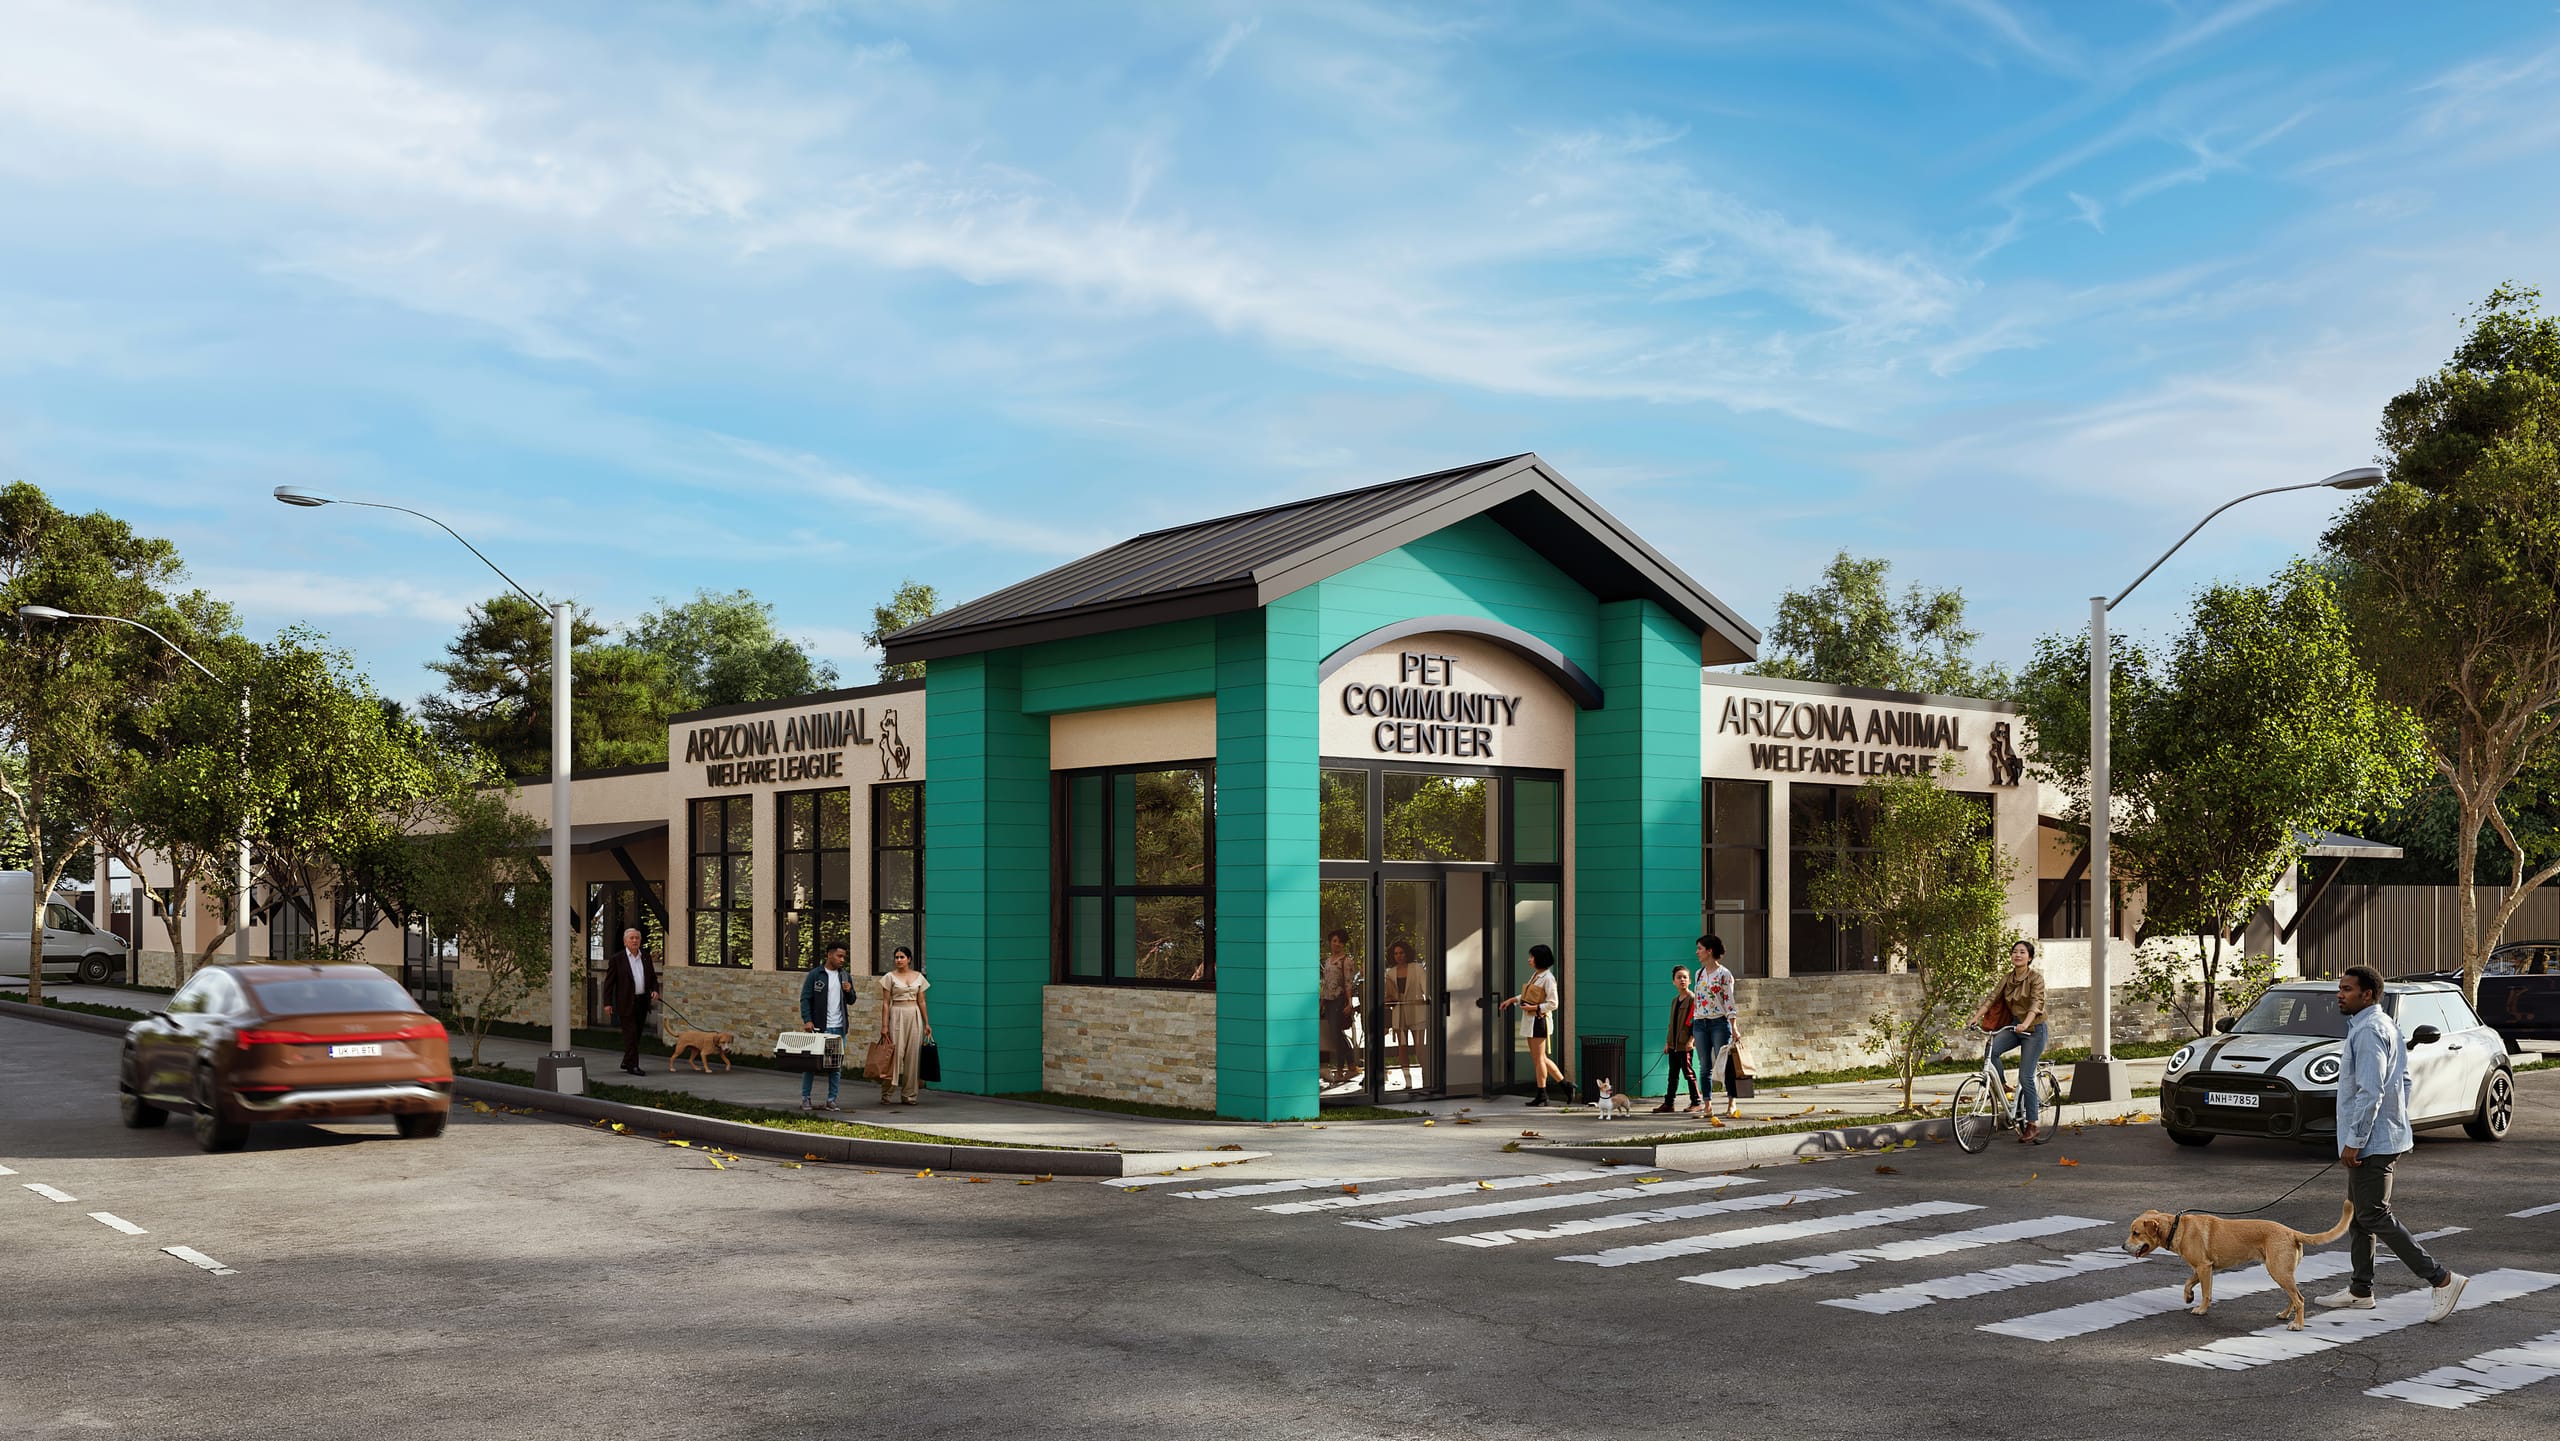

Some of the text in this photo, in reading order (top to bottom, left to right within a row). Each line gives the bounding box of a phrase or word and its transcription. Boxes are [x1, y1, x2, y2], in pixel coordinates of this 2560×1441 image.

[1402, 652, 1459, 686] PET
[1343, 682, 1521, 726] COMMUNITY
[685, 707, 874, 763] ARIZONA ANIMAL
[1375, 720, 1493, 757] CENTER
[1718, 695, 1969, 751] ARIZONA ANIMAL
[705, 751, 843, 787] WELFARE LEAGUE
[1750, 743, 1937, 779] WELFARE LEAGUE
